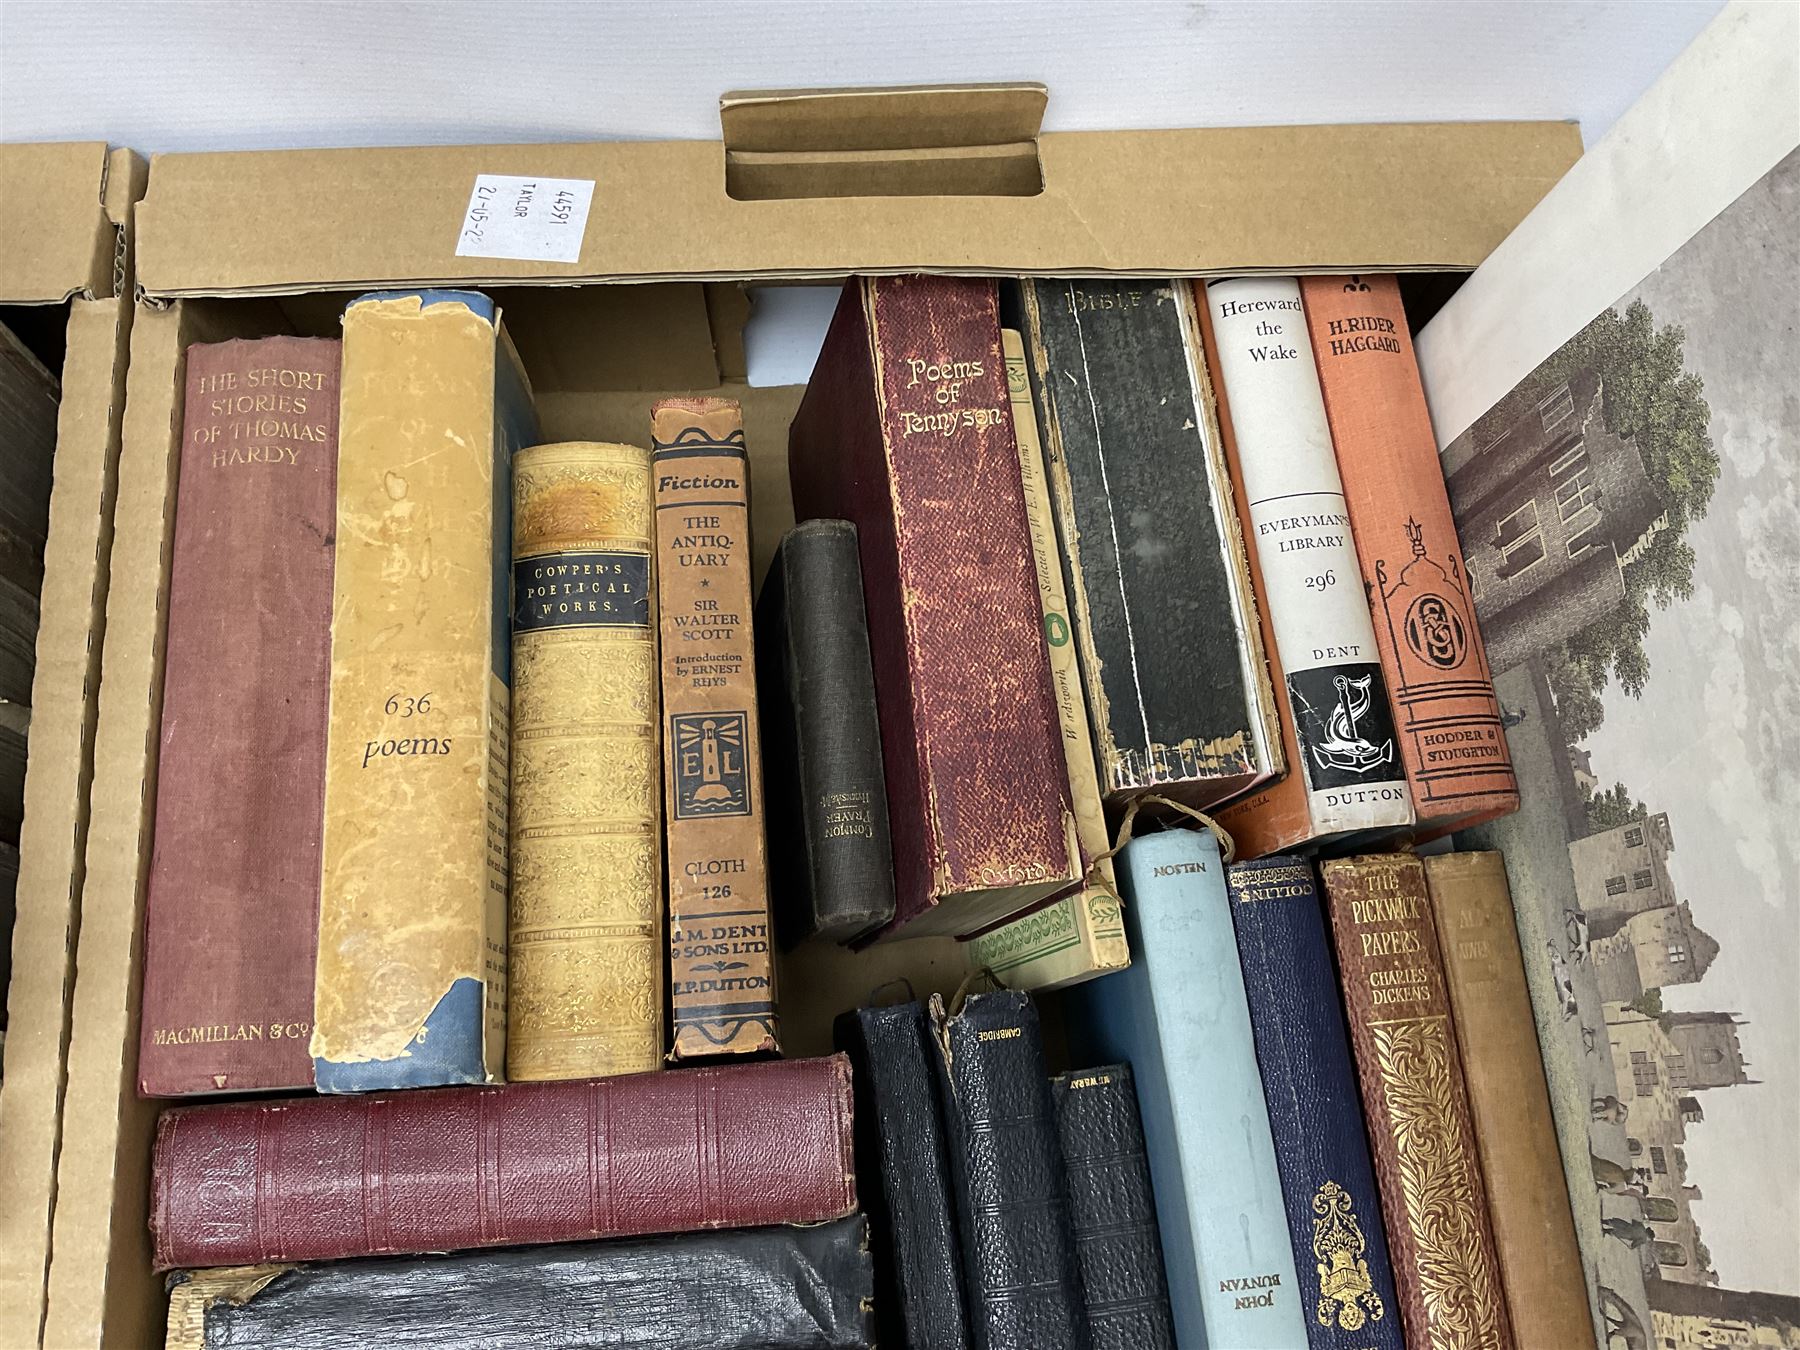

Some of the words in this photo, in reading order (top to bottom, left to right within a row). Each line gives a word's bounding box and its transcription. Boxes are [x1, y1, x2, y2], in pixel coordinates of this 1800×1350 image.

[514, 183, 536, 218] TAYLOR
[549, 190, 574, 225] 44591
[1064, 291, 1143, 313] BIBLE
[1220, 297, 1302, 319] Hereward
[1255, 320, 1283, 337] the
[1249, 345, 1298, 363] Wake
[1328, 335, 1402, 357] HAGGARD
[200, 372, 237, 394] THE
[247, 369, 327, 391] SHORT
[906, 358, 985, 389] Poems
[935, 383, 962, 405] of
[212, 395, 307, 417] STORIES
[194, 425, 221, 445] OF
[229, 420, 327, 443] THOMAS
[900, 407, 1002, 439] Tennyson
[212, 446, 301, 469] HARDY
[1020, 443, 1033, 492] Williams
[657, 475, 740, 494] Fiction
[683, 516, 721, 530] THE
[1259, 514, 1351, 536] EVERYMAN'S
[671, 534, 735, 549] ANTIQ-
[1033, 534, 1045, 545] by
[1279, 534, 1345, 553] LIBRARY
[678, 553, 730, 568] UARY
[534, 564, 622, 580] COWPER'S
[1034, 549, 1052, 592] Selected
[527, 582, 632, 599] POETICAL
[1304, 569, 1336, 593] 296
[541, 600, 619, 615] WORKS.
[693, 600, 719, 612] SIR
[674, 613, 741, 627] WALTER
[682, 628, 735, 642] SCOTT
[675, 652, 743, 665] Introduction
[1312, 644, 1361, 661] DENT
[676, 666, 689, 678] by
[691, 663, 742, 676] ERNEST
[691, 676, 728, 688] RHYS
[384, 691, 434, 719] 636
[1054, 669, 1078, 740] Wrdsworth
[1423, 730, 1484, 747] HODDER
[362, 735, 453, 769] poems
[1427, 744, 1502, 763] STOUGHTON
[682, 752, 701, 777] E
[723, 751, 741, 776] L
[1327, 788, 1405, 807] DUTTON
[826, 810, 870, 824] PRAYER
[824, 824, 873, 840] COMMON
[684, 859, 746, 877] CLOTH
[981, 862, 1047, 884] Oxford
[1153, 862, 1206, 878] NELSON
[1365, 874, 1399, 892] THE
[701, 885, 732, 901] 126
[1240, 883, 1314, 903] COLLINS
[1351, 896, 1421, 925] PICKWICK
[712, 924, 767, 940] DENT
[684, 942, 730, 958] SONS
[732, 941, 769, 955] LTD.
[1360, 930, 1421, 957] PAPERS
[1369, 967, 1428, 988] CHARLES
[1372, 985, 1431, 1005] DICKENS
[152, 1024, 263, 1046] MACMILLAN
[977, 1027, 1021, 1042] CAMBRIDGE
[1219, 1273, 1282, 1293] BUNYAN
[1235, 1289, 1274, 1310] JOHN
